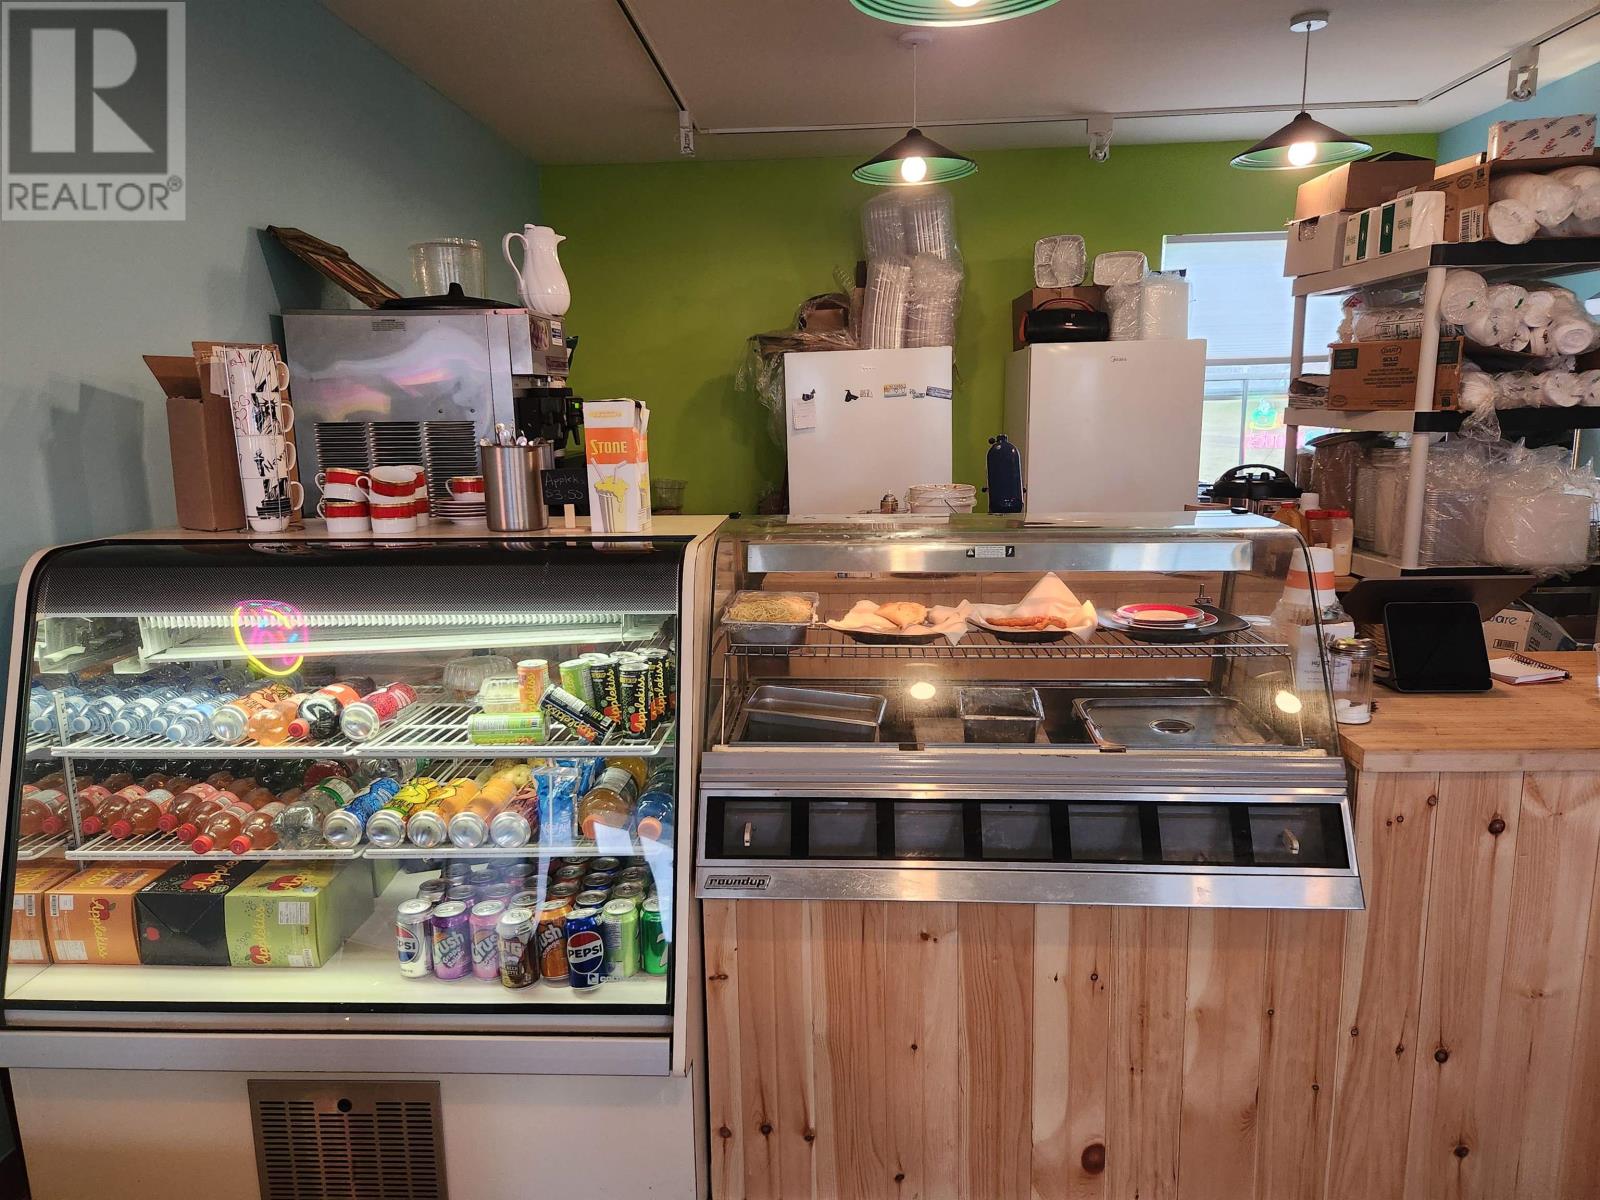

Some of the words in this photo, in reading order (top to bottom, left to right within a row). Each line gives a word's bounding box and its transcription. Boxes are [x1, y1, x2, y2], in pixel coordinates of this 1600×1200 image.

[633, 674, 648, 734] Applekiss
[709, 877, 766, 888] roundup
[568, 944, 603, 959] PEPSI
